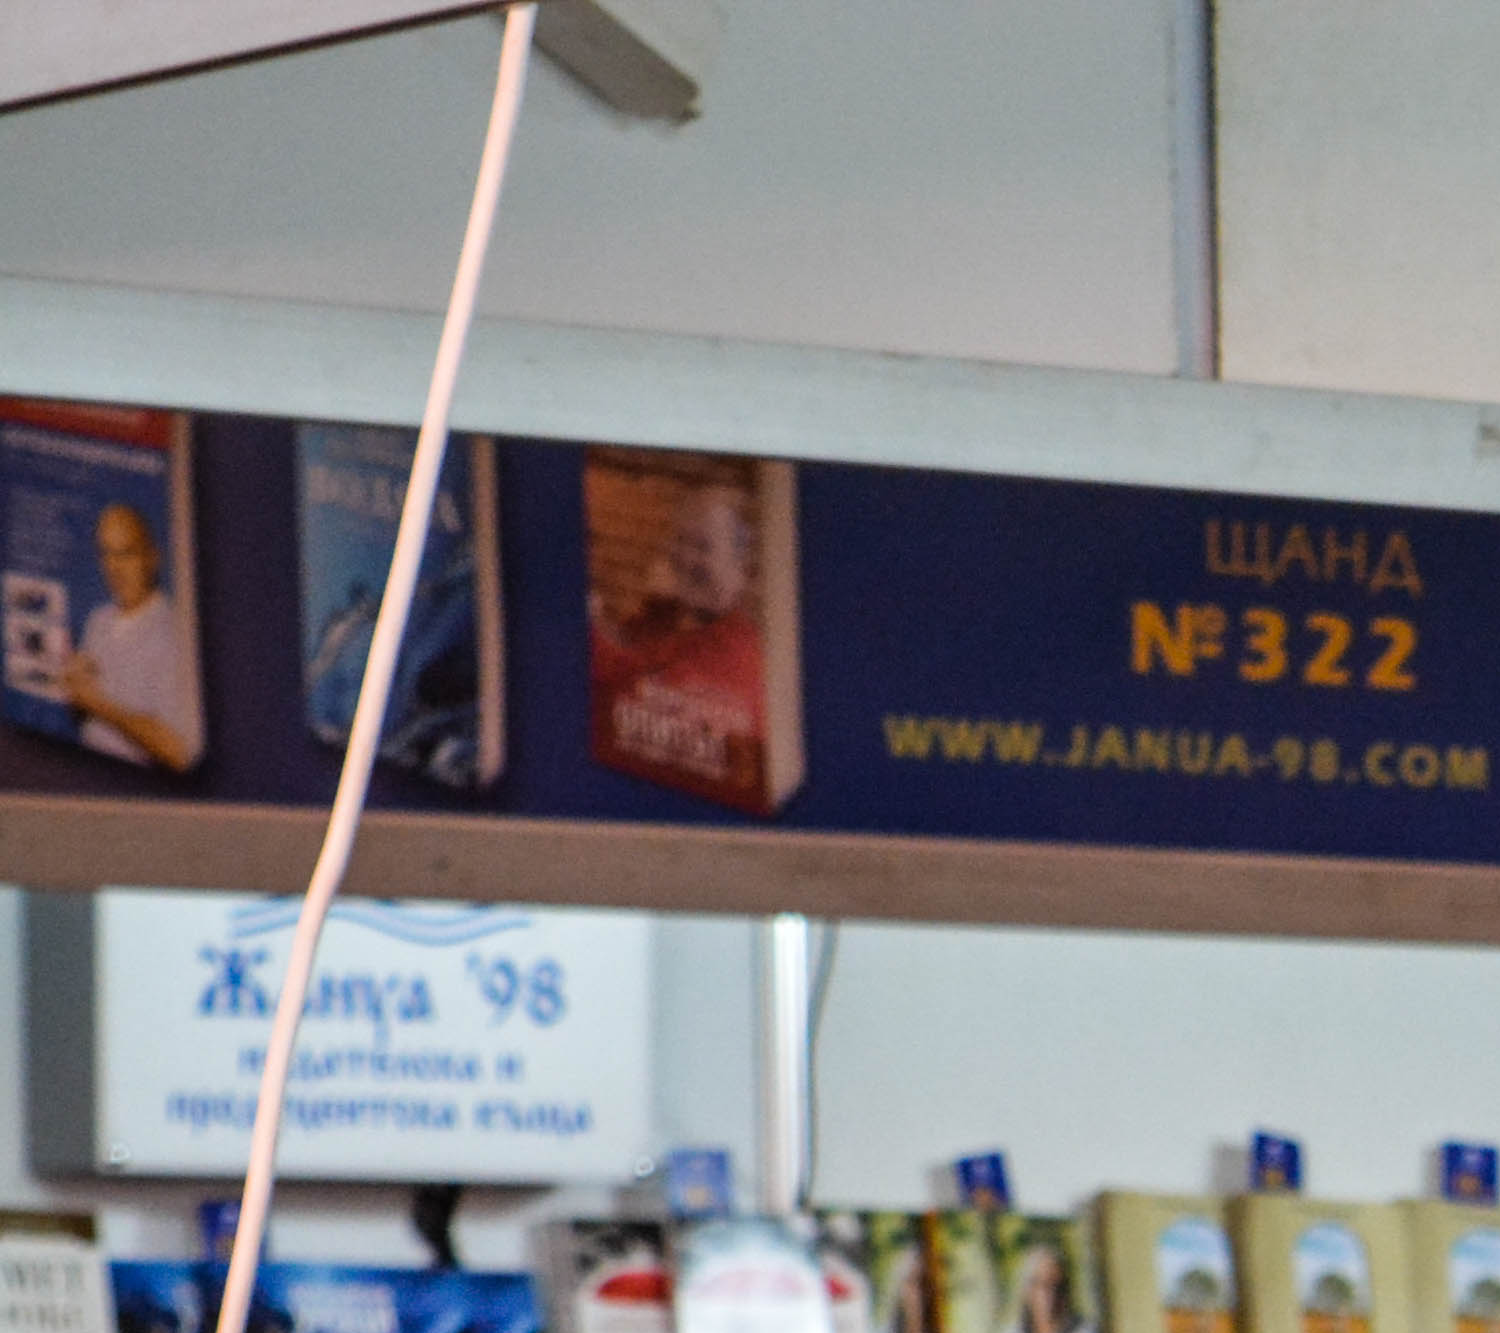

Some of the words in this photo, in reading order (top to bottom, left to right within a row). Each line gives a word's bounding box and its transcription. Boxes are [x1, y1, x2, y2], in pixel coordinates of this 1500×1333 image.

[1203, 519, 1423, 595] ЩАНД
[882, 714, 1489, 791] WWW.JANUA-98.COM
[195, 946, 434, 1046] Жнуа
[237, 1044, 480, 1083] идателска
